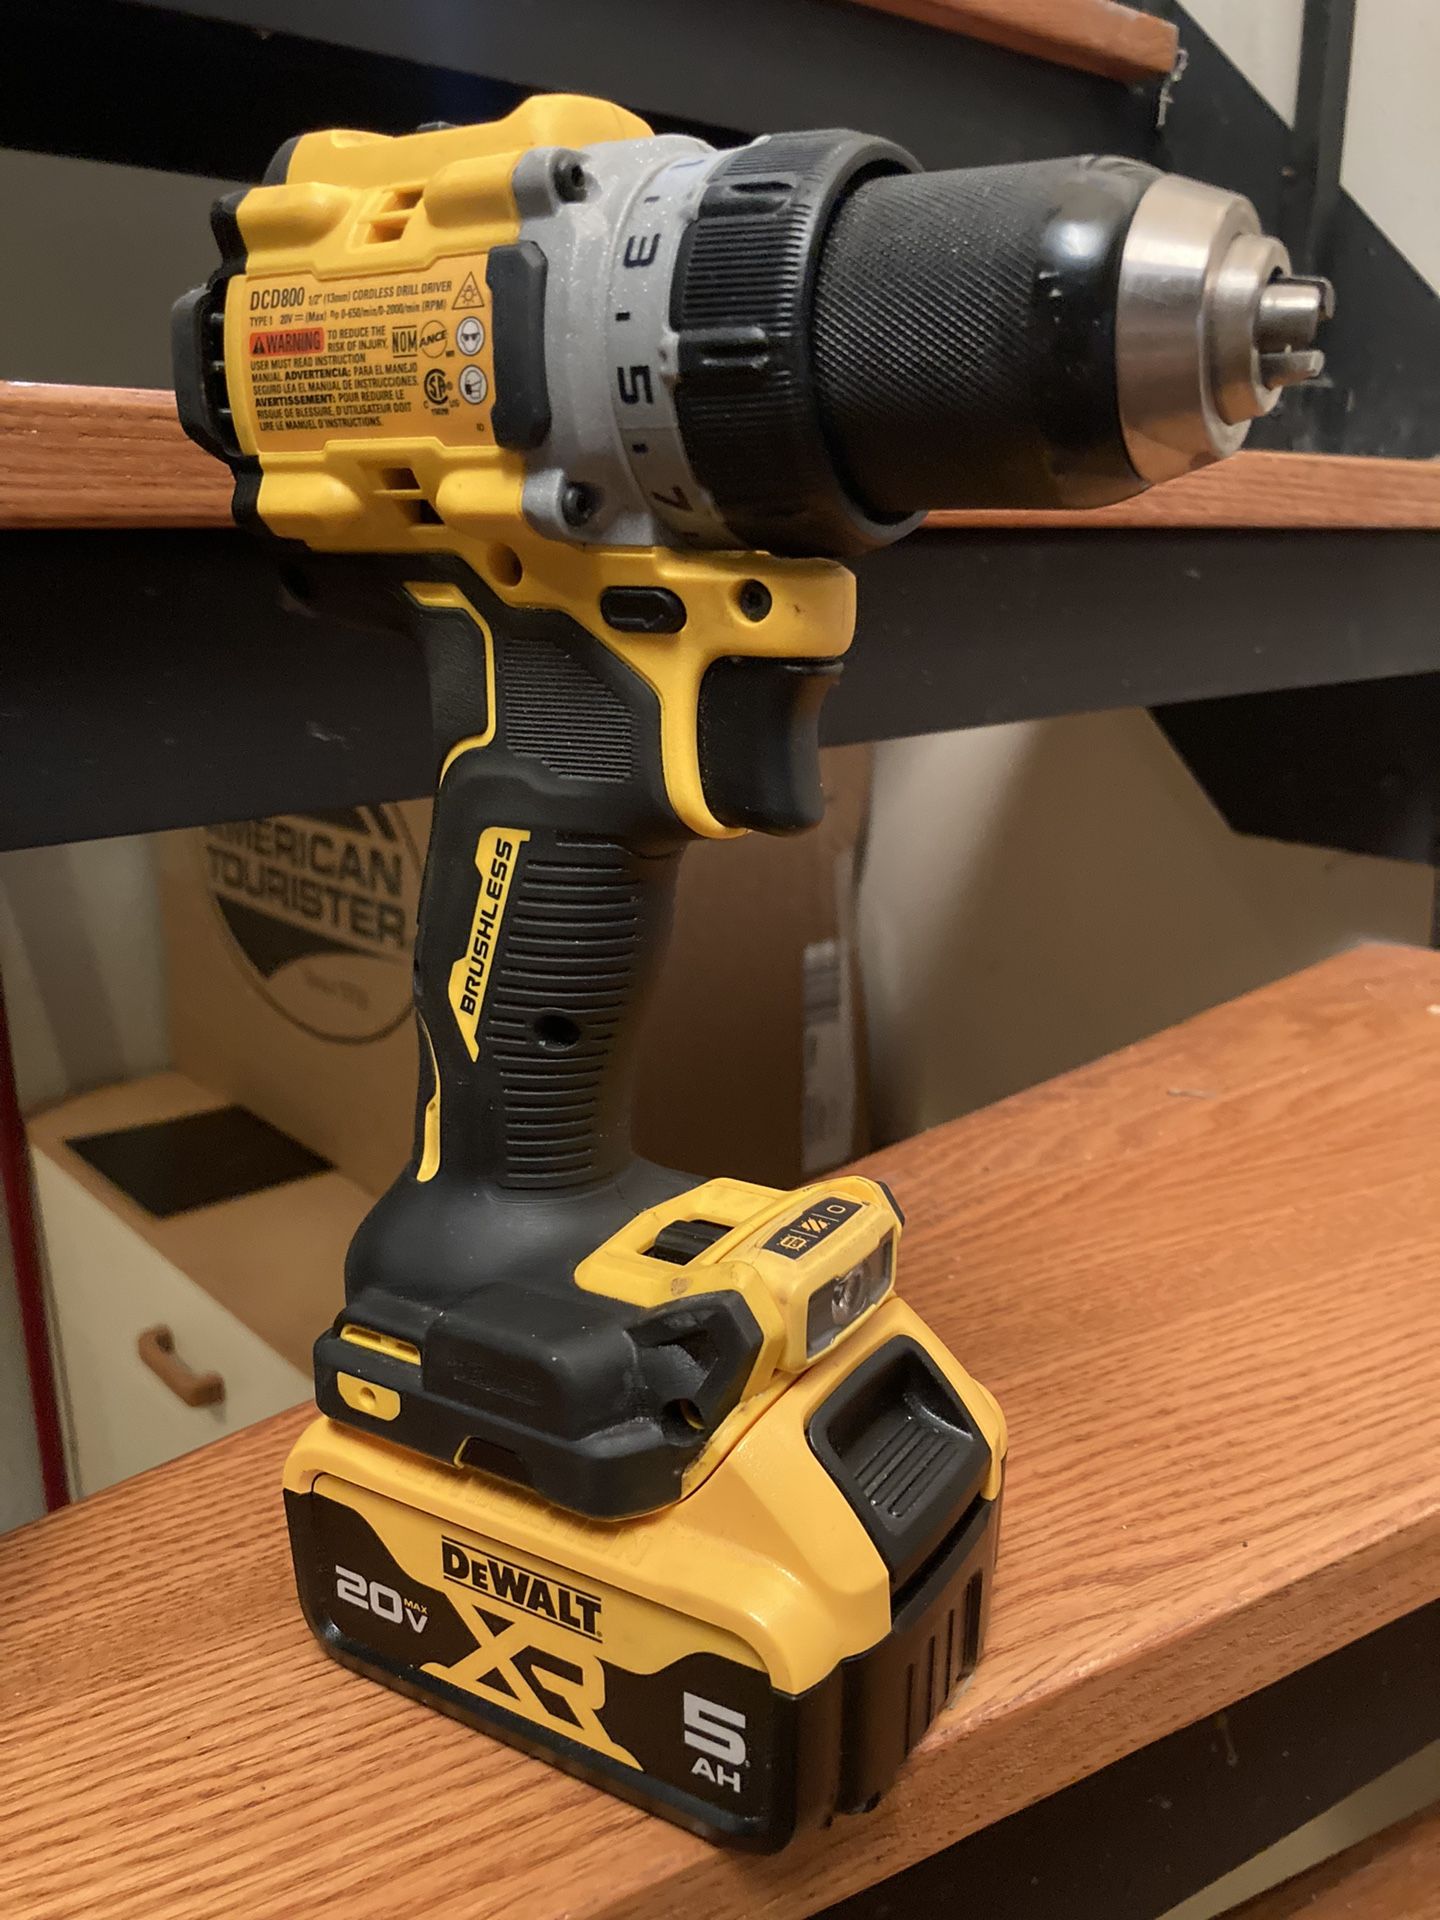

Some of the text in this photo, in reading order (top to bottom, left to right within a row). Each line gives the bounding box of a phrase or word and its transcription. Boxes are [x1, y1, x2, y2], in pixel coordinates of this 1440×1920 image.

[623, 232, 661, 268] 3
[250, 287, 305, 311] DCD800
[323, 291, 351, 305] (13mm)
[353, 287, 395, 300] CORDLESS
[396, 284, 419, 297] DRILL
[421, 280, 453, 294] DRIVER
[249, 315, 268, 327] TYPE
[279, 313, 293, 325] 20V
[421, 299, 447, 313] (RPM)
[266, 331, 321, 353] WARNING
[327, 325, 386, 340] TO REDUCE THE
[392, 330, 418, 353] NOM
[419, 329, 448, 348] ANCE
[328, 341, 345, 353] RISK
[347, 341, 358, 351] OF
[250, 353, 366, 371] USER MUST READ INSTRUCTION
[285, 367, 351, 381] ADVERTENCIA:
[353, 365, 374, 376] PARA
[375, 364, 384, 375] EL
[385, 363, 418, 374] MANEJO
[253, 384, 282, 396] SEGURO
[283, 382, 297, 394] LEA
[298, 382, 307, 393] EL
[308, 379, 342, 392] MANUAL
[343, 378, 353, 390] DE
[617, 365, 654, 405] 5
[255, 393, 337, 408] AVERTISSEMENT:
[338, 392, 359, 403] POUR
[395, 389, 405, 400] LE
[257, 408, 283, 420] RISQUE
[284, 408, 294, 418] DE
[393, 402, 412, 413] DOIT
[259, 421, 274, 432] LIRE
[275, 420, 285, 431] LE
[286, 418, 318, 431] MANUEL
[206, 842, 406, 948] TOURISTER
[460, 838, 513, 1016] BRUSHLESS
[403, 1597, 428, 1616] MAX
[419, 1602, 644, 1772] XR
[683, 1690, 746, 1766] 5
[691, 1757, 741, 1793] AH
